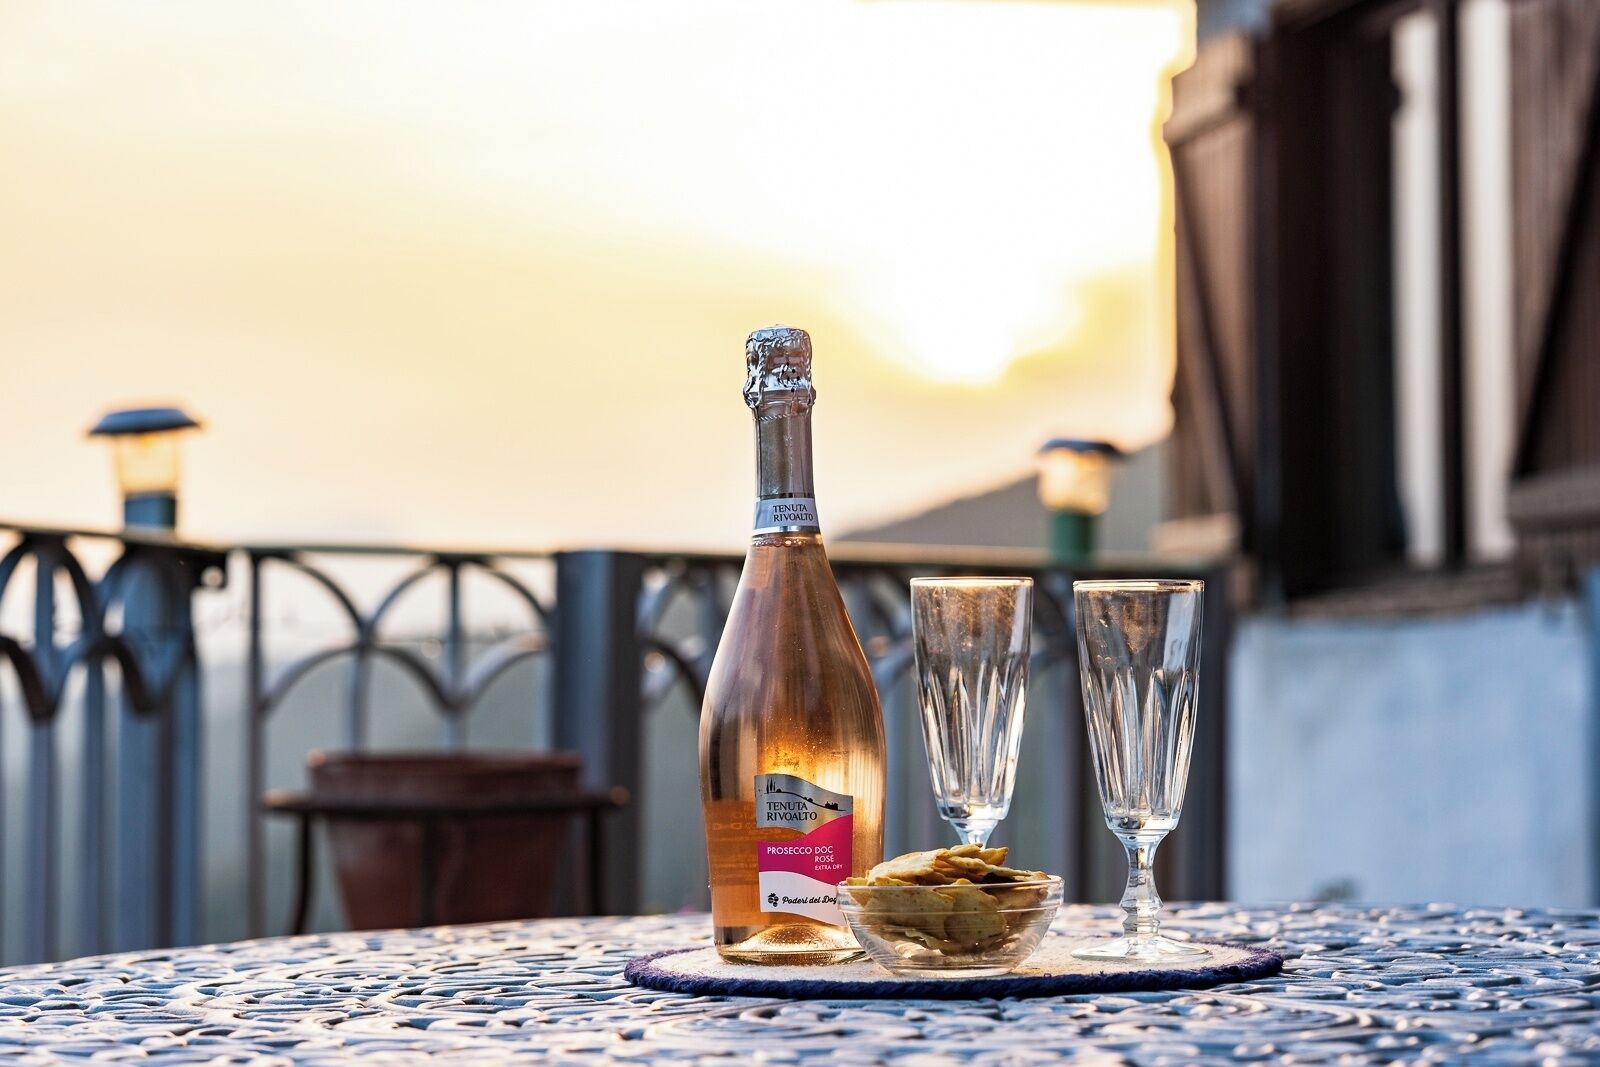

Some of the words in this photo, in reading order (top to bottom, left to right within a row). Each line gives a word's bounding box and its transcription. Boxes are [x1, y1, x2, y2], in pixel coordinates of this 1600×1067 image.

[773, 504, 807, 512] TENUTA
[773, 513, 813, 521] RIVOALTO
[766, 801, 808, 810] TENUTA
[767, 811, 817, 820] RIVOALTO
[767, 846, 812, 854] PROSECCO
